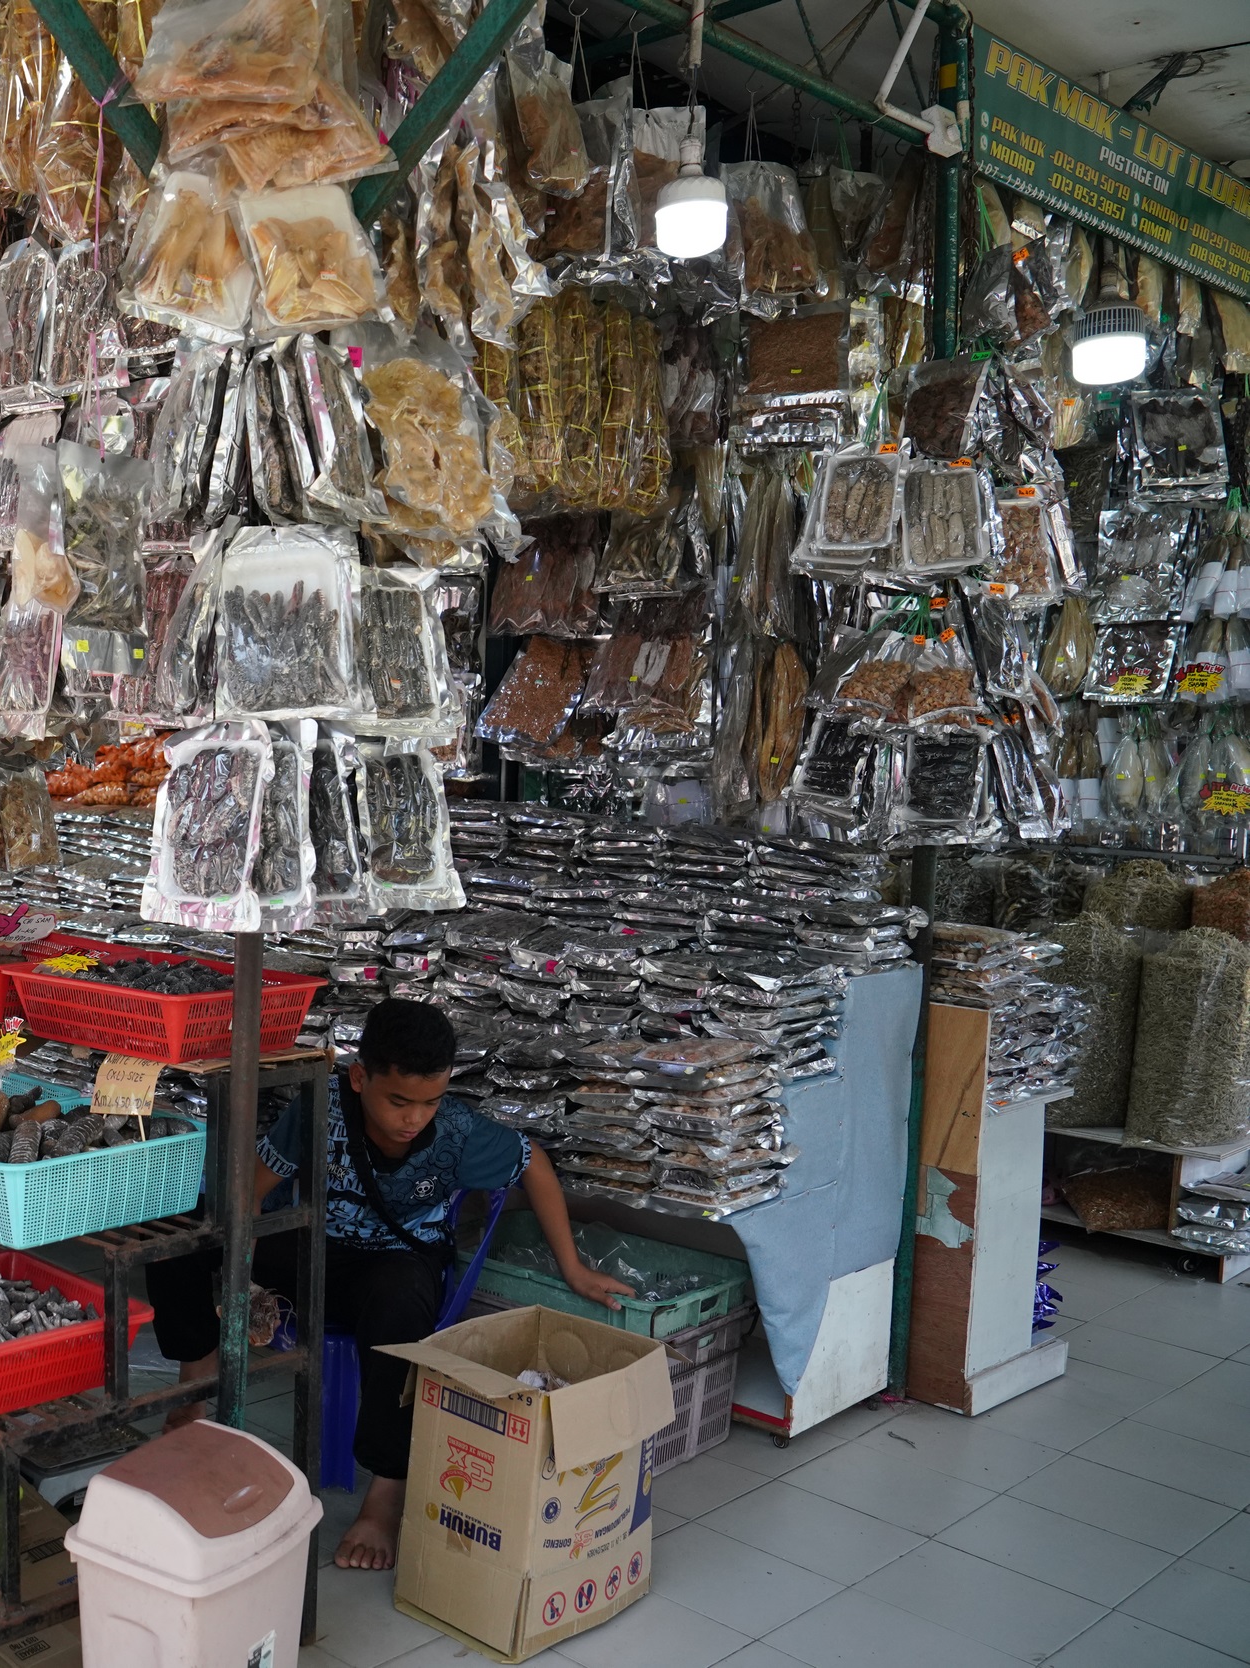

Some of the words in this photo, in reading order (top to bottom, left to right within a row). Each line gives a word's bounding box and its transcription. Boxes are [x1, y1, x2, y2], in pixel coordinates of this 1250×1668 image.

[985, 38, 1056, 108] PAK
[1053, 78, 1120, 144] MOK
[1133, 123, 1185, 177] LOT
[1186, 154, 1200, 188] 1
[992, 116, 1020, 144] PAK
[1019, 131, 1047, 159] MOK
[1076, 162, 1100, 186] 834
[1099, 174, 1131, 201] 5079
[1099, 145, 1153, 186] POSTAGE
[1153, 175, 1170, 196] ON
[990, 140, 1036, 176] MADAR
[1073, 185, 1098, 208] 853
[1098, 197, 1126, 221] 3851
[1014, 177, 1045, 201] PASAR
[1045, 193, 1068, 213] IKAN
[1068, 204, 1099, 227] MASIN
[1099, 219, 1141, 248] SINSURAN
[1141, 240, 1163, 259] KOTA
[1163, 252, 1202, 276] KINABALU
[1201, 269, 1226, 289] SABAH
[1141, 196, 1189, 232] KANDAYO
[1210, 232, 1229, 252] 297
[1139, 217, 1173, 244] AIMAN
[1208, 254, 1227, 271] 962
[1133, 667, 1152, 676] NEW
[1203, 664, 1225, 674] NEW
[4, 1016, 24, 1034] NEW
[127, 1071, 146, 1082] SIZE
[439, 1508, 502, 1552] BURUH
[465, 1513, 482, 1525] MASAK
[483, 1522, 502, 1534] MINYAK
[594, 1504, 631, 1539] PERLINDUNGAN
[543, 1537, 572, 1549] GORENG!
